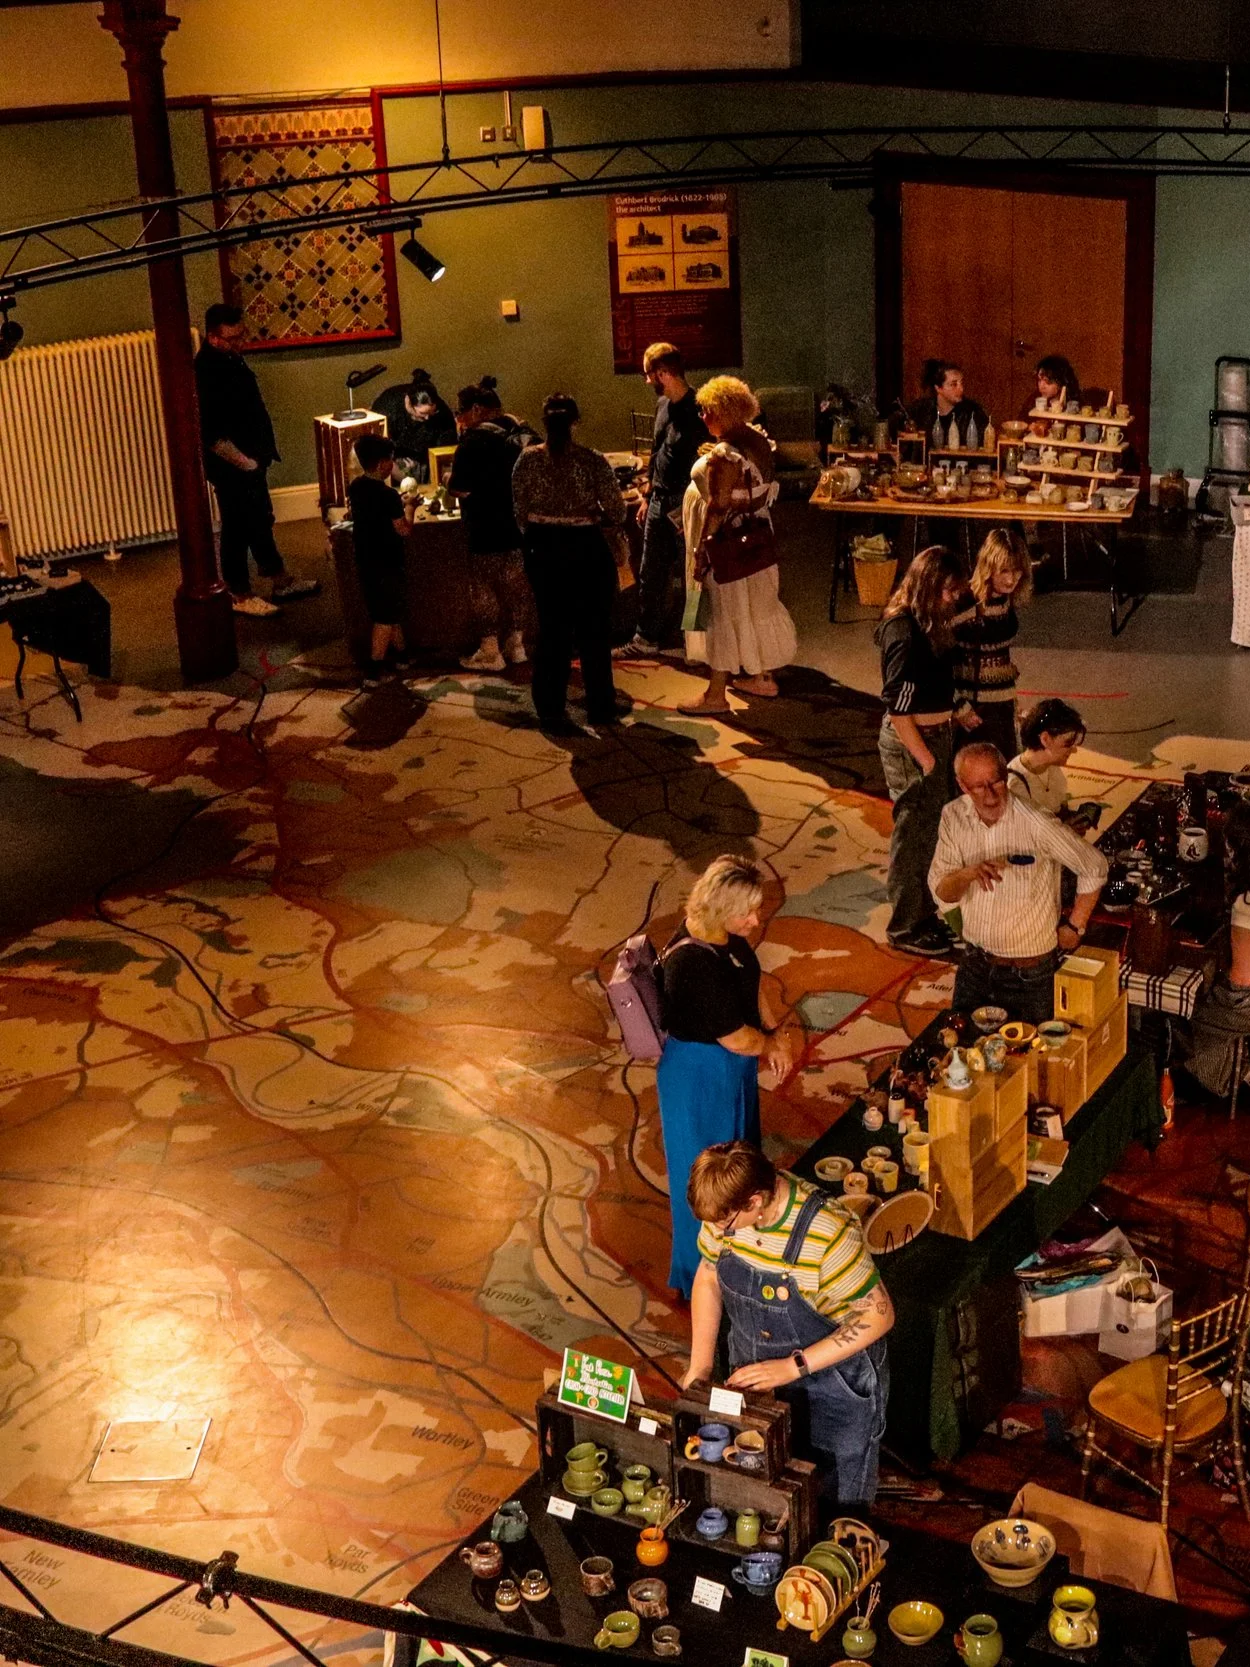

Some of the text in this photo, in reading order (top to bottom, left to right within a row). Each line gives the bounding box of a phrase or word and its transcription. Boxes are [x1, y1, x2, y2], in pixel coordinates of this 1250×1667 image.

[480, 1286, 535, 1307] Armley
[411, 1425, 475, 1451] Wortley
[456, 1487, 500, 1506] Green
[451, 1499, 485, 1516] Side
[22, 1549, 65, 1571] New
